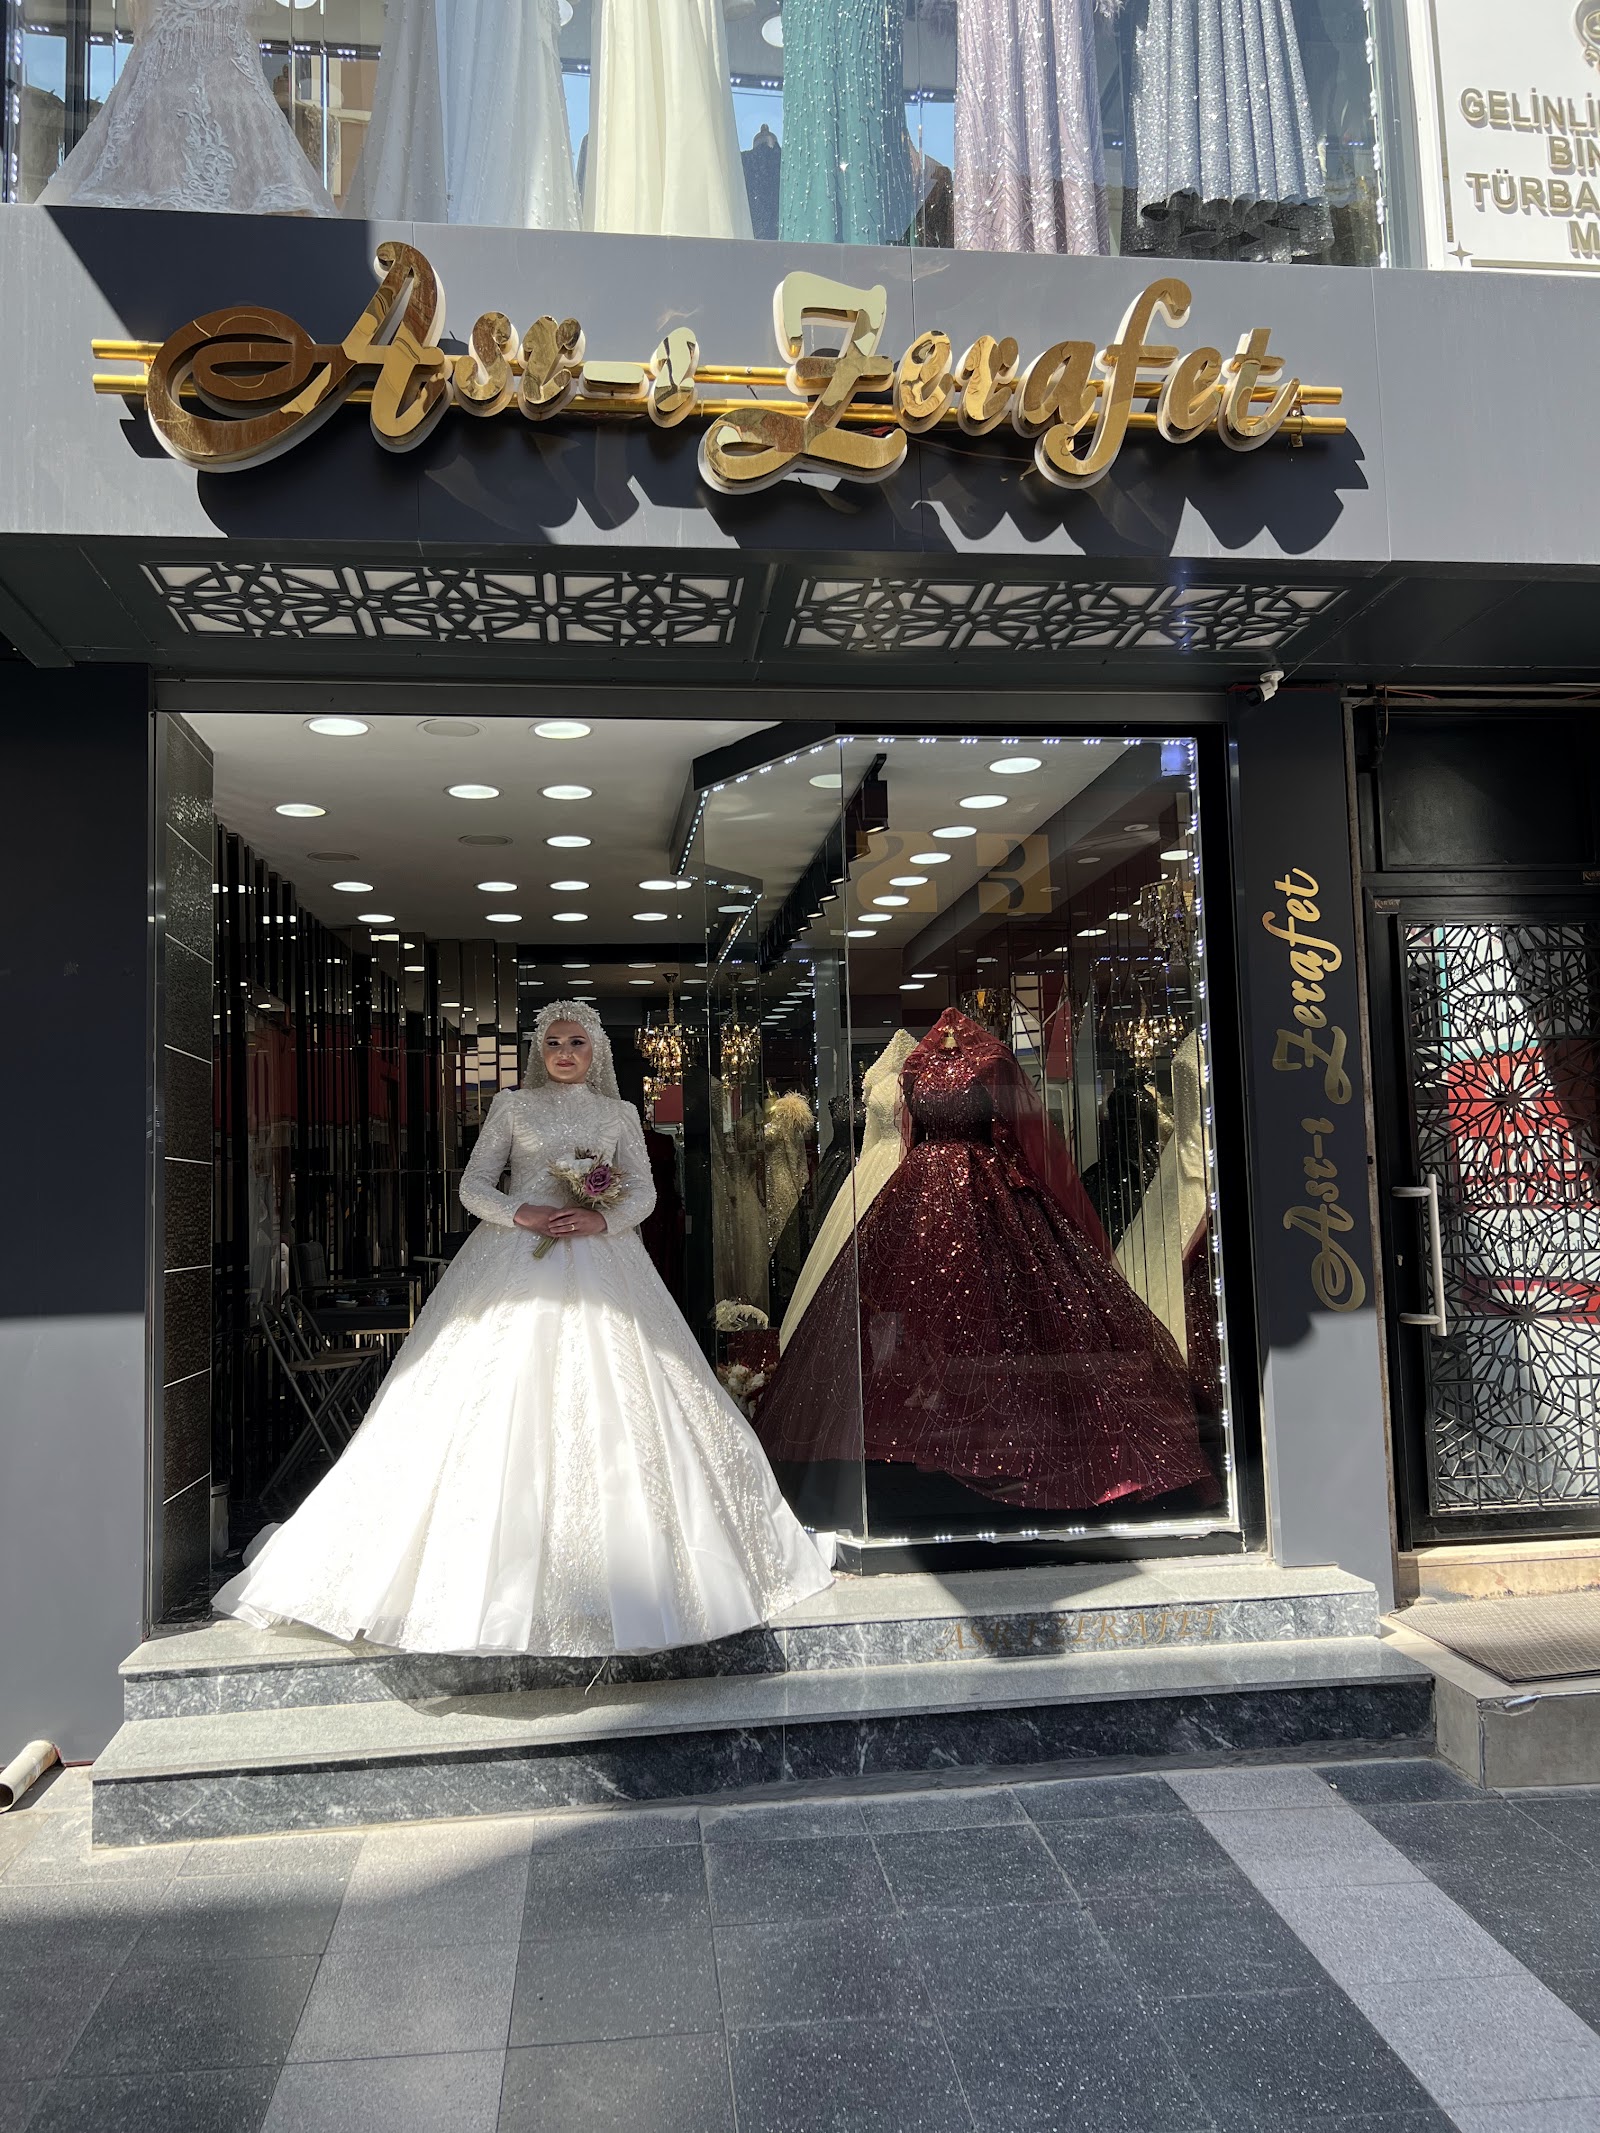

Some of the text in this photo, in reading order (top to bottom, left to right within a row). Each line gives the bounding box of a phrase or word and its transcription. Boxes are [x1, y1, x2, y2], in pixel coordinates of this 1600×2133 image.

[1459, 87, 1600, 130] GELİNLİ
[698, 270, 1300, 494] Zerafet
[1262, 867, 1352, 1104] Zerafet
